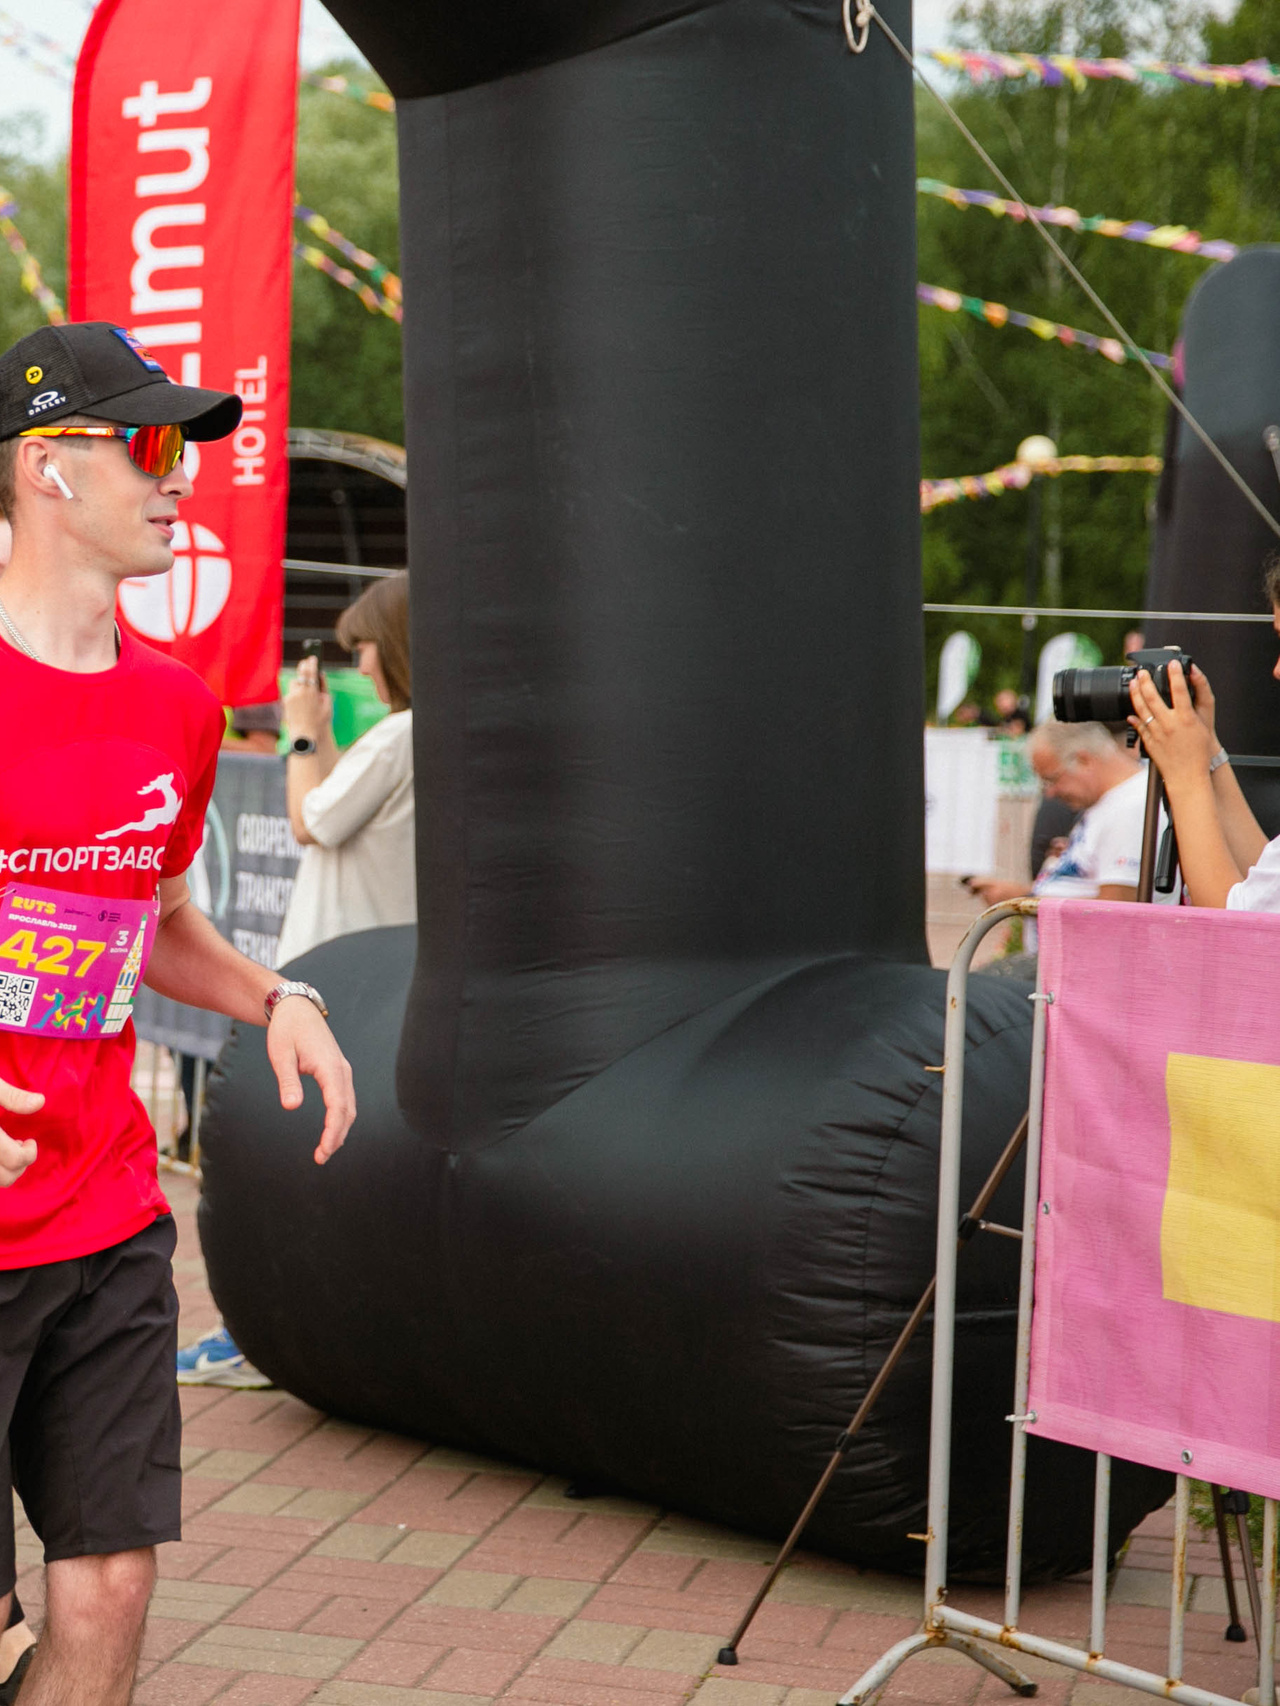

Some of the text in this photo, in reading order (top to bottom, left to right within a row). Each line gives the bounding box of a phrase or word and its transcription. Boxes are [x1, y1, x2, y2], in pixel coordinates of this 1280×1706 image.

[121, 76, 213, 484] imut
[28, 396, 67, 416] OAKLEY
[232, 355, 268, 487] HOTEL
[11, 895, 57, 915] RUTS
[115, 930, 130, 947] 3
